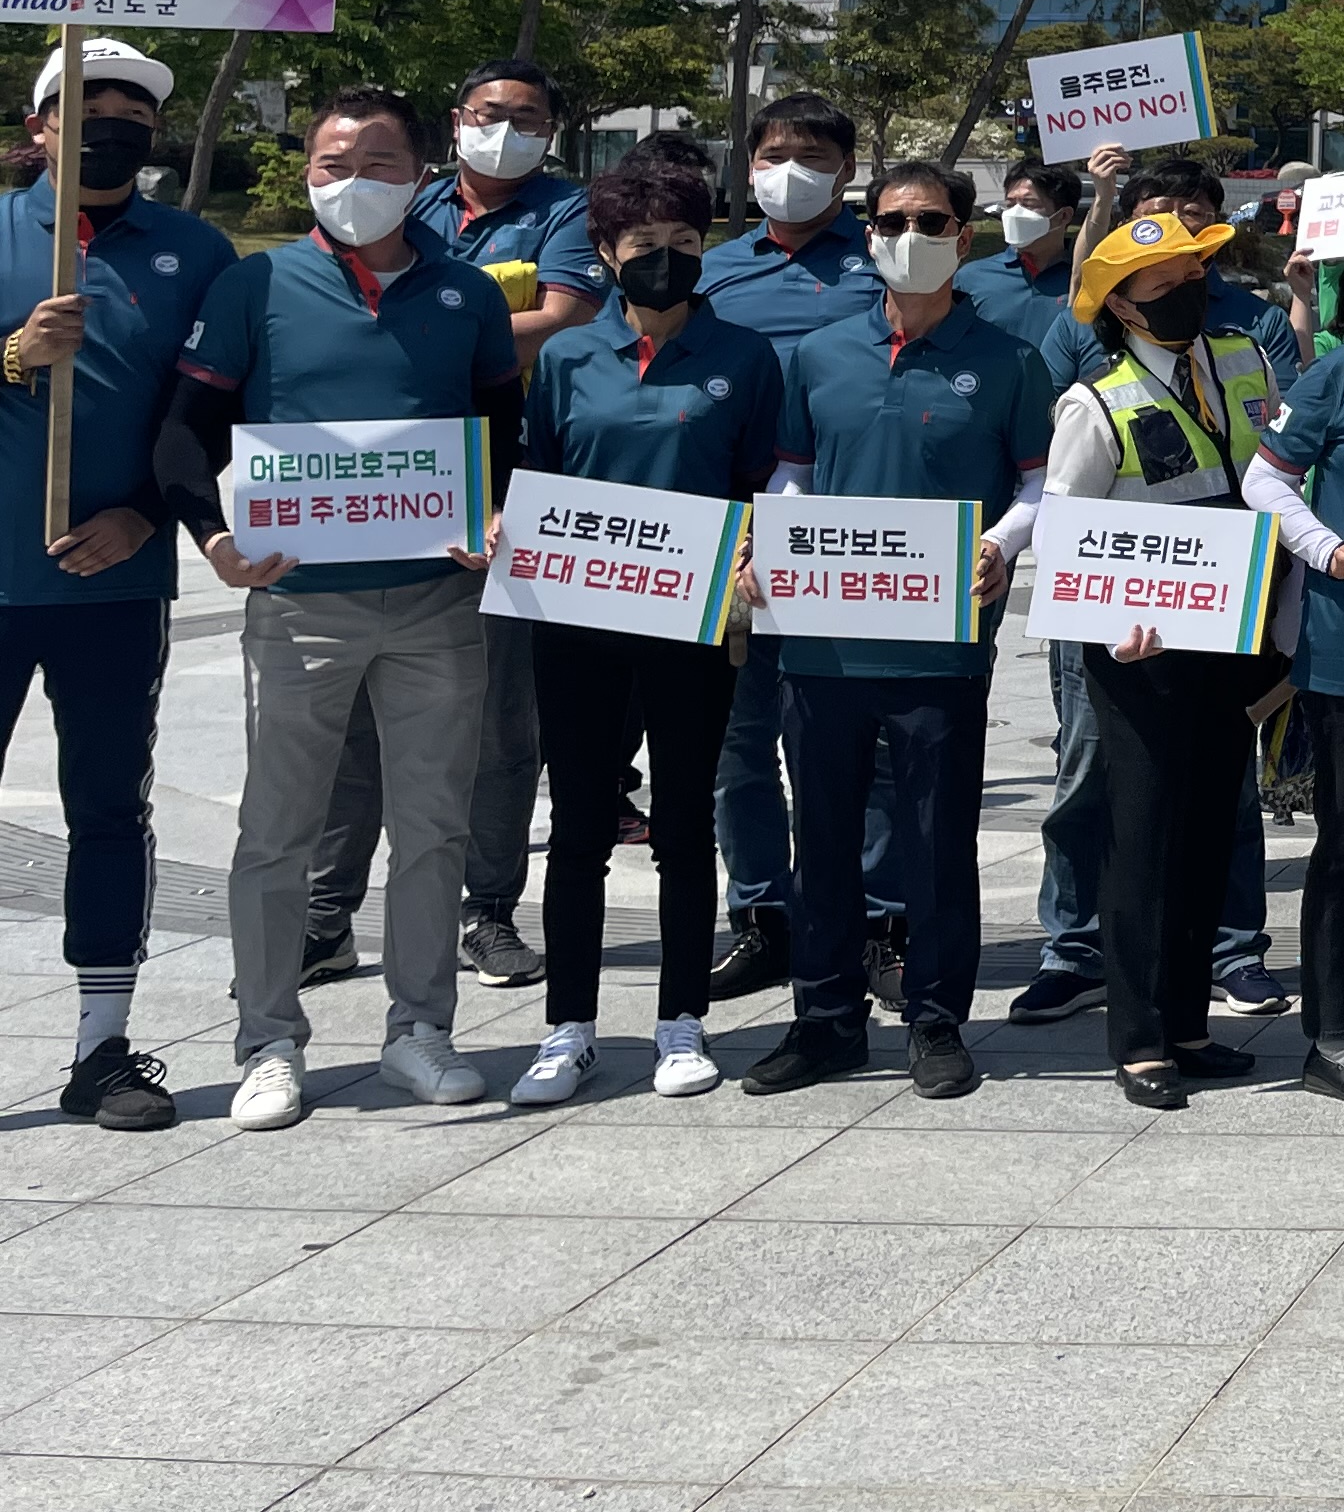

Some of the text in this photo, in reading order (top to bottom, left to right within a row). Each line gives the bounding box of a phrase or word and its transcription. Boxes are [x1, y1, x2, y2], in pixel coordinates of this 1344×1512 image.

[1059, 64, 1165, 99] 음주운전..
[1047, 90, 1187, 134] NO NO NO!
[250, 449, 452, 483] 어린이보호구역..
[249, 497, 300, 528] 불법
[538, 506, 683, 555] 신호위반..
[788, 526, 925, 558] 횡단보도..
[1078, 529, 1217, 567] 신호위반..
[509, 548, 694, 601] 절대 안돼요!
[770, 569, 940, 603] 잠시 멈춰요!
[1052, 571, 1229, 612] 절대 안돼요!
